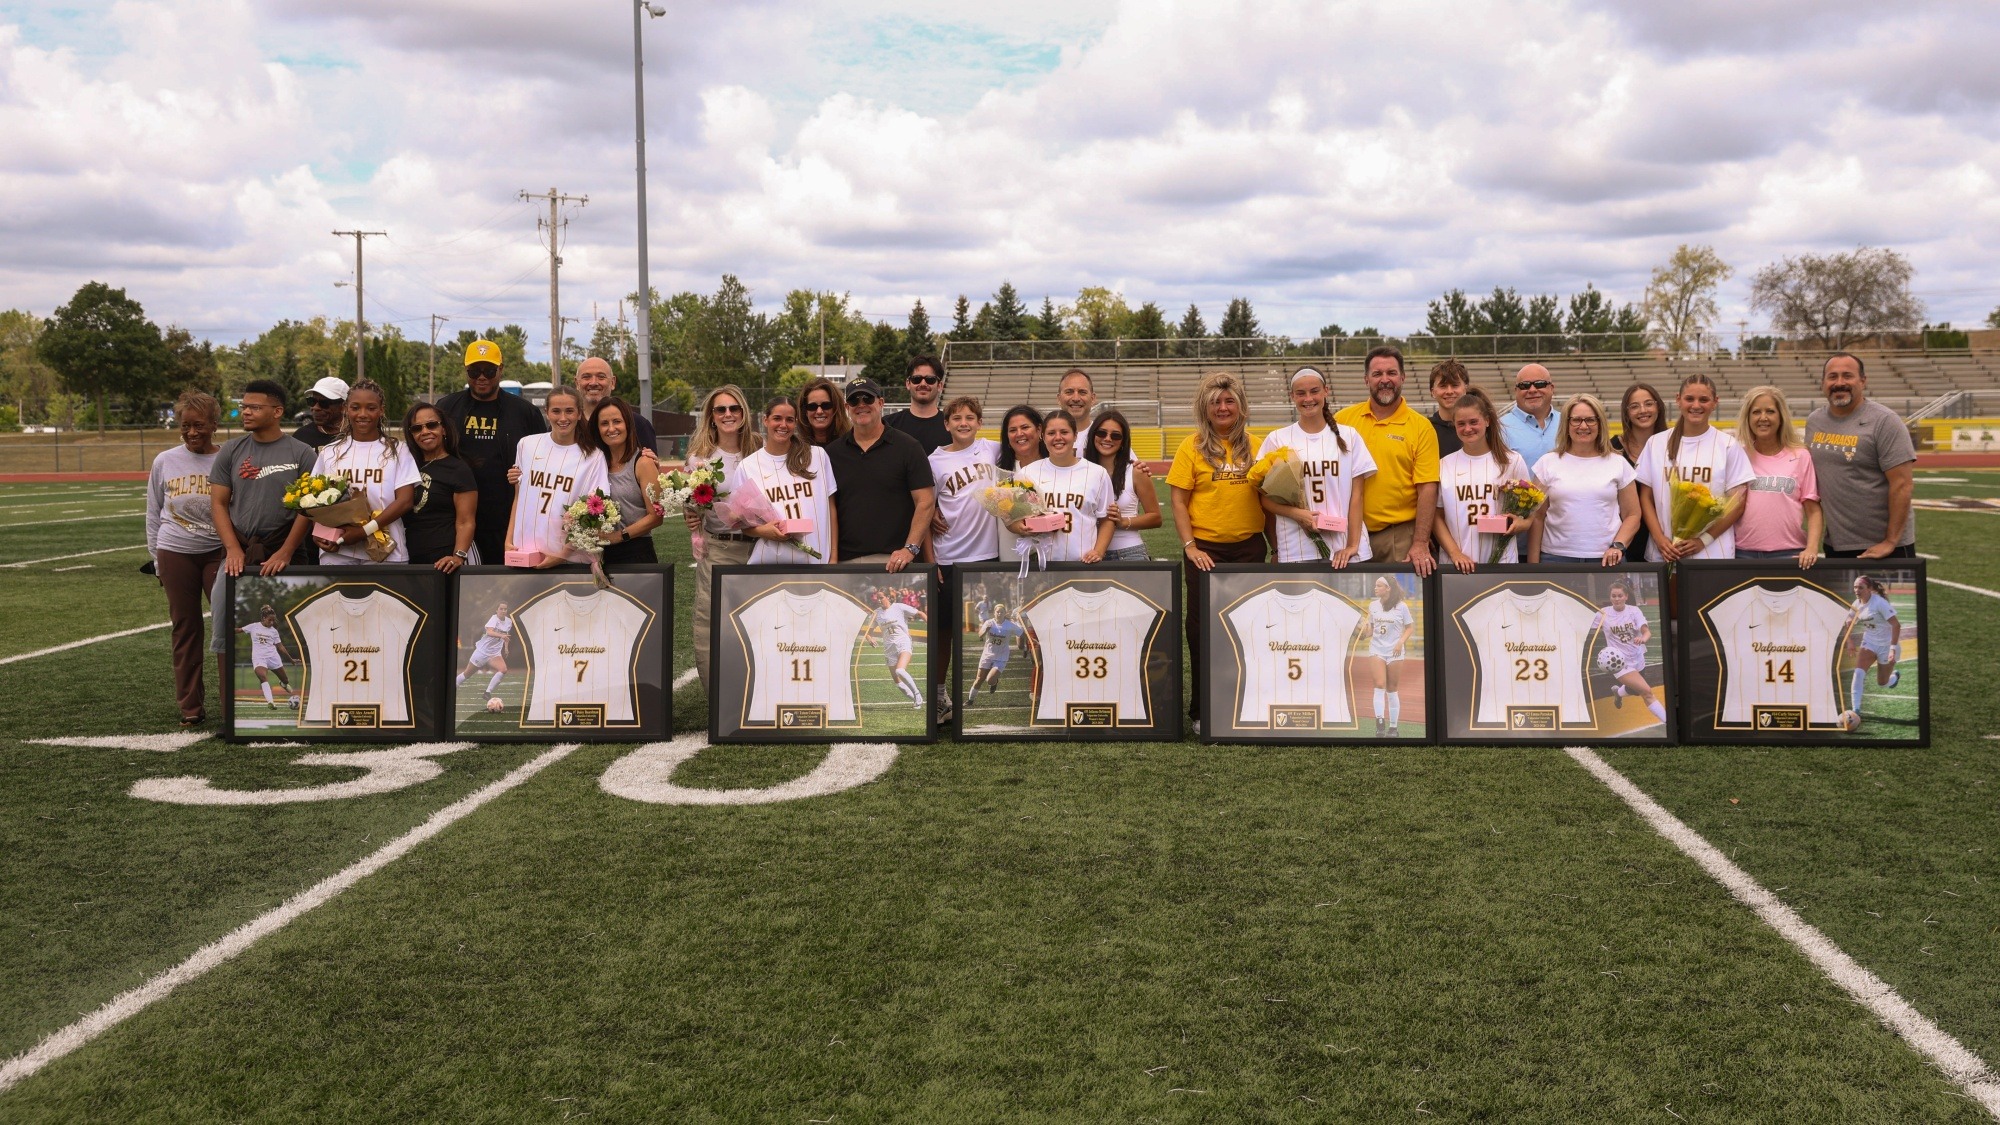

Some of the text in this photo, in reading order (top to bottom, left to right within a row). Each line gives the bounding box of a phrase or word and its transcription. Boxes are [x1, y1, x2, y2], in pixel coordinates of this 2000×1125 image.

[1810, 443, 1857, 453] SOCCER
[1813, 431, 1858, 447] VALPARAISO
[1303, 460, 1339, 477] ALPO
[530, 470, 573, 493] VALPO
[945, 463, 993, 496] VALPO
[766, 481, 813, 503] VALPO
[1311, 480, 1324, 503] 5
[540, 492, 552, 514] 7
[785, 502, 801, 519] 11
[1380, 625, 1387, 635] 5
[332, 643, 381, 656] Valparaiso
[558, 643, 606, 656] Valparaiso
[777, 642, 827, 655] Valparaiso
[1066, 640, 1117, 652] Valparaiso
[1268, 641, 1320, 654] Valparaiso
[1504, 642, 1557, 655] Valparaiso
[1751, 642, 1806, 655] Valparaiso
[344, 660, 370, 682] 21
[574, 660, 589, 682] 7
[791, 659, 813, 681] 11
[1075, 656, 1107, 679] 33
[1288, 658, 1302, 680] 5
[1515, 658, 1549, 681] 23
[1765, 659, 1794, 683] 14
